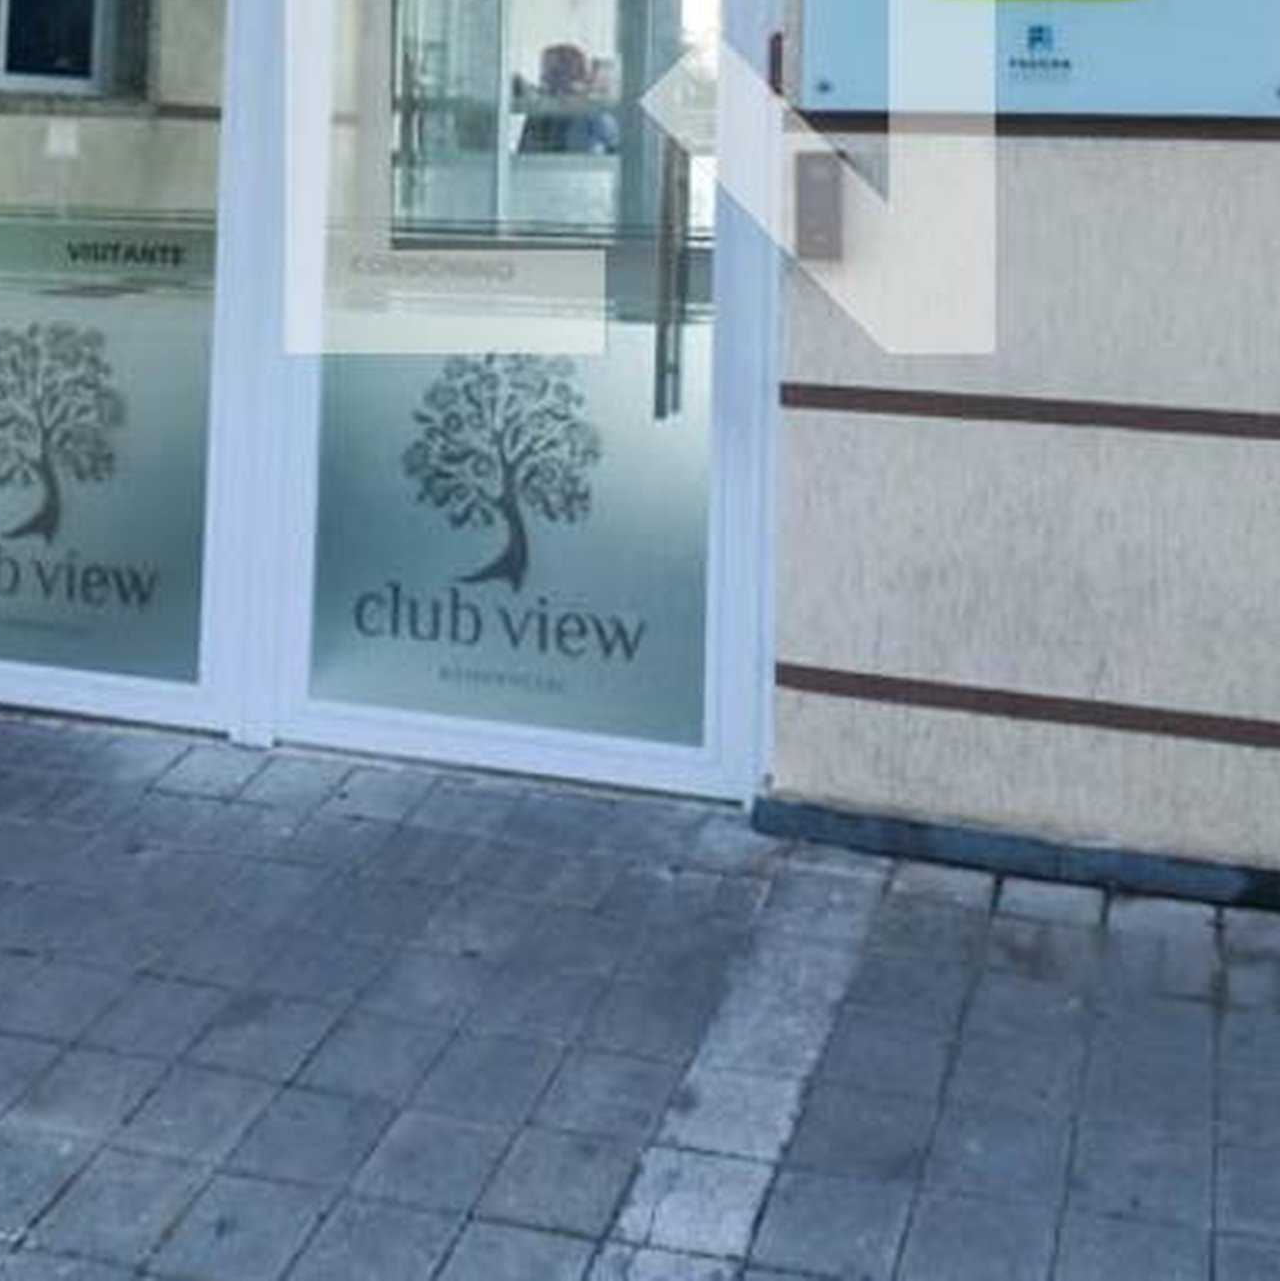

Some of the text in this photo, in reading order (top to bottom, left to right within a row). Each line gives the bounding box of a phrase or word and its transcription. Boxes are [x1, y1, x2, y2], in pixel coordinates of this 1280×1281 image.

[66, 241, 187, 267] VISITANTE
[28, 549, 160, 609] view
[351, 582, 648, 663] club view
